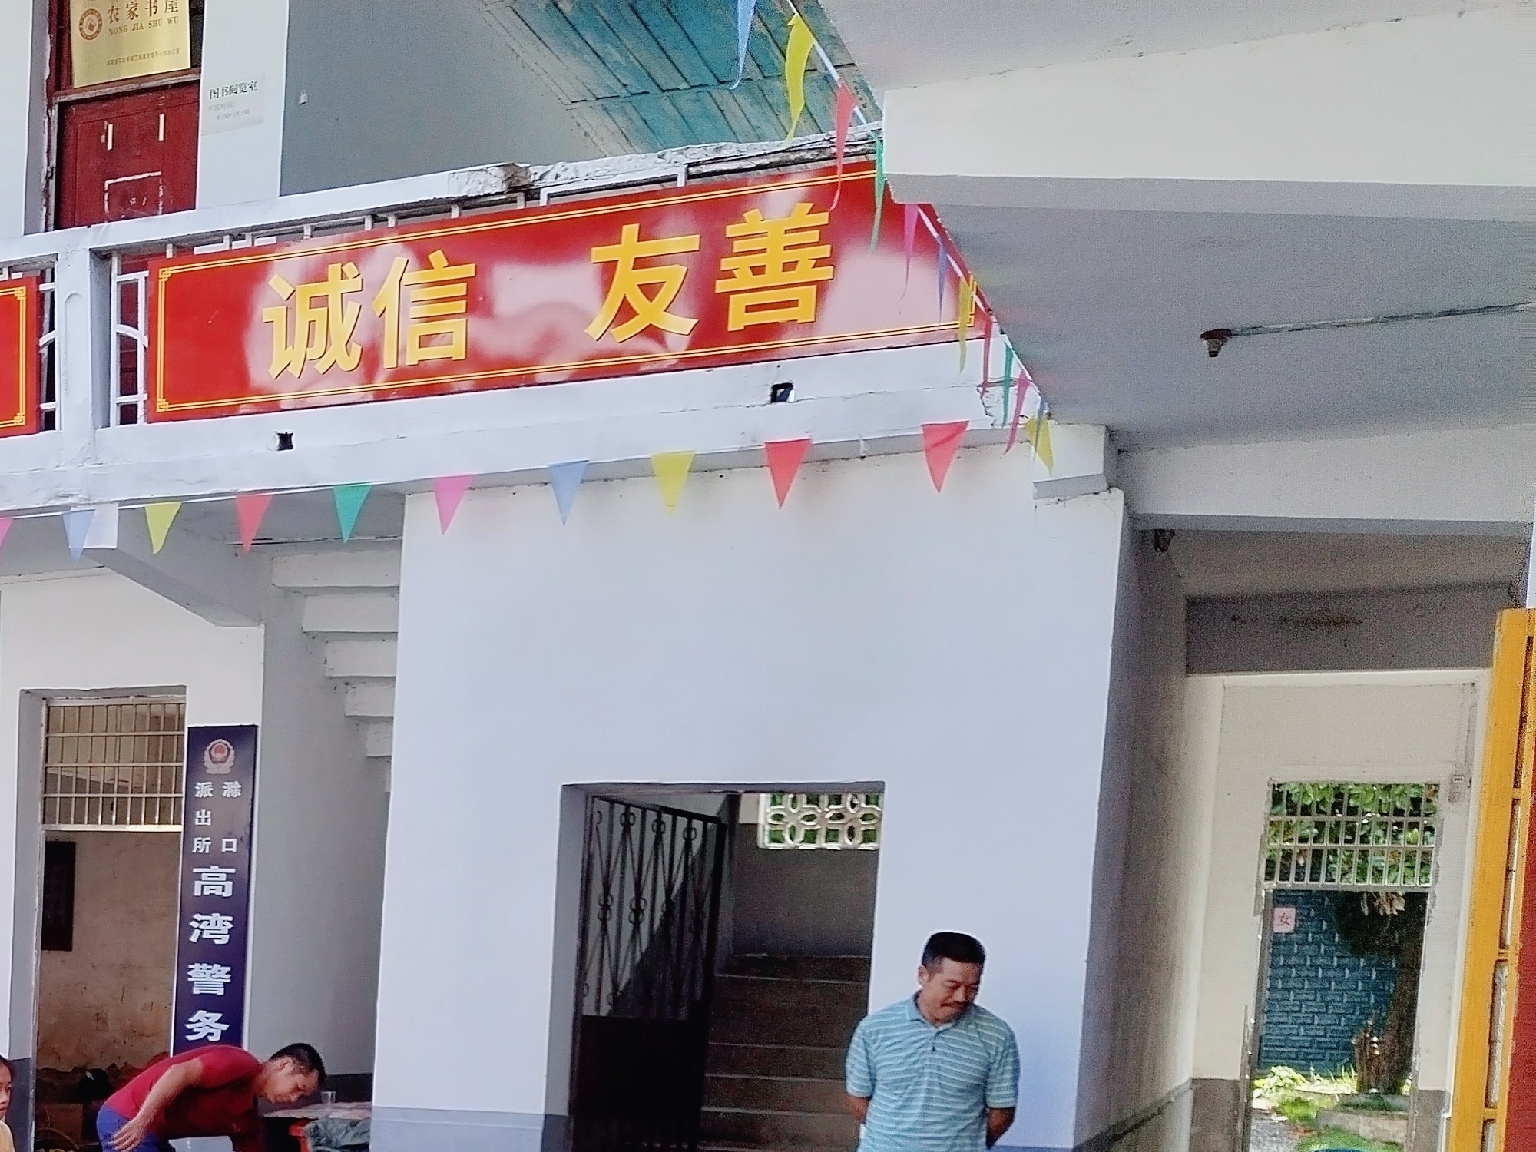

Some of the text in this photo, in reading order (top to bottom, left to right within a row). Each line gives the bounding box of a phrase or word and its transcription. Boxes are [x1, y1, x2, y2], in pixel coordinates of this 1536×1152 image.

[107, 0, 179, 24] 农家书屋
[108, 16, 179, 35] NONG JIA SHU WU
[262, 203, 835, 381] 诚信 友善
[193, 781, 215, 853] 派出所
[185, 865, 237, 1042] 高湾警务
